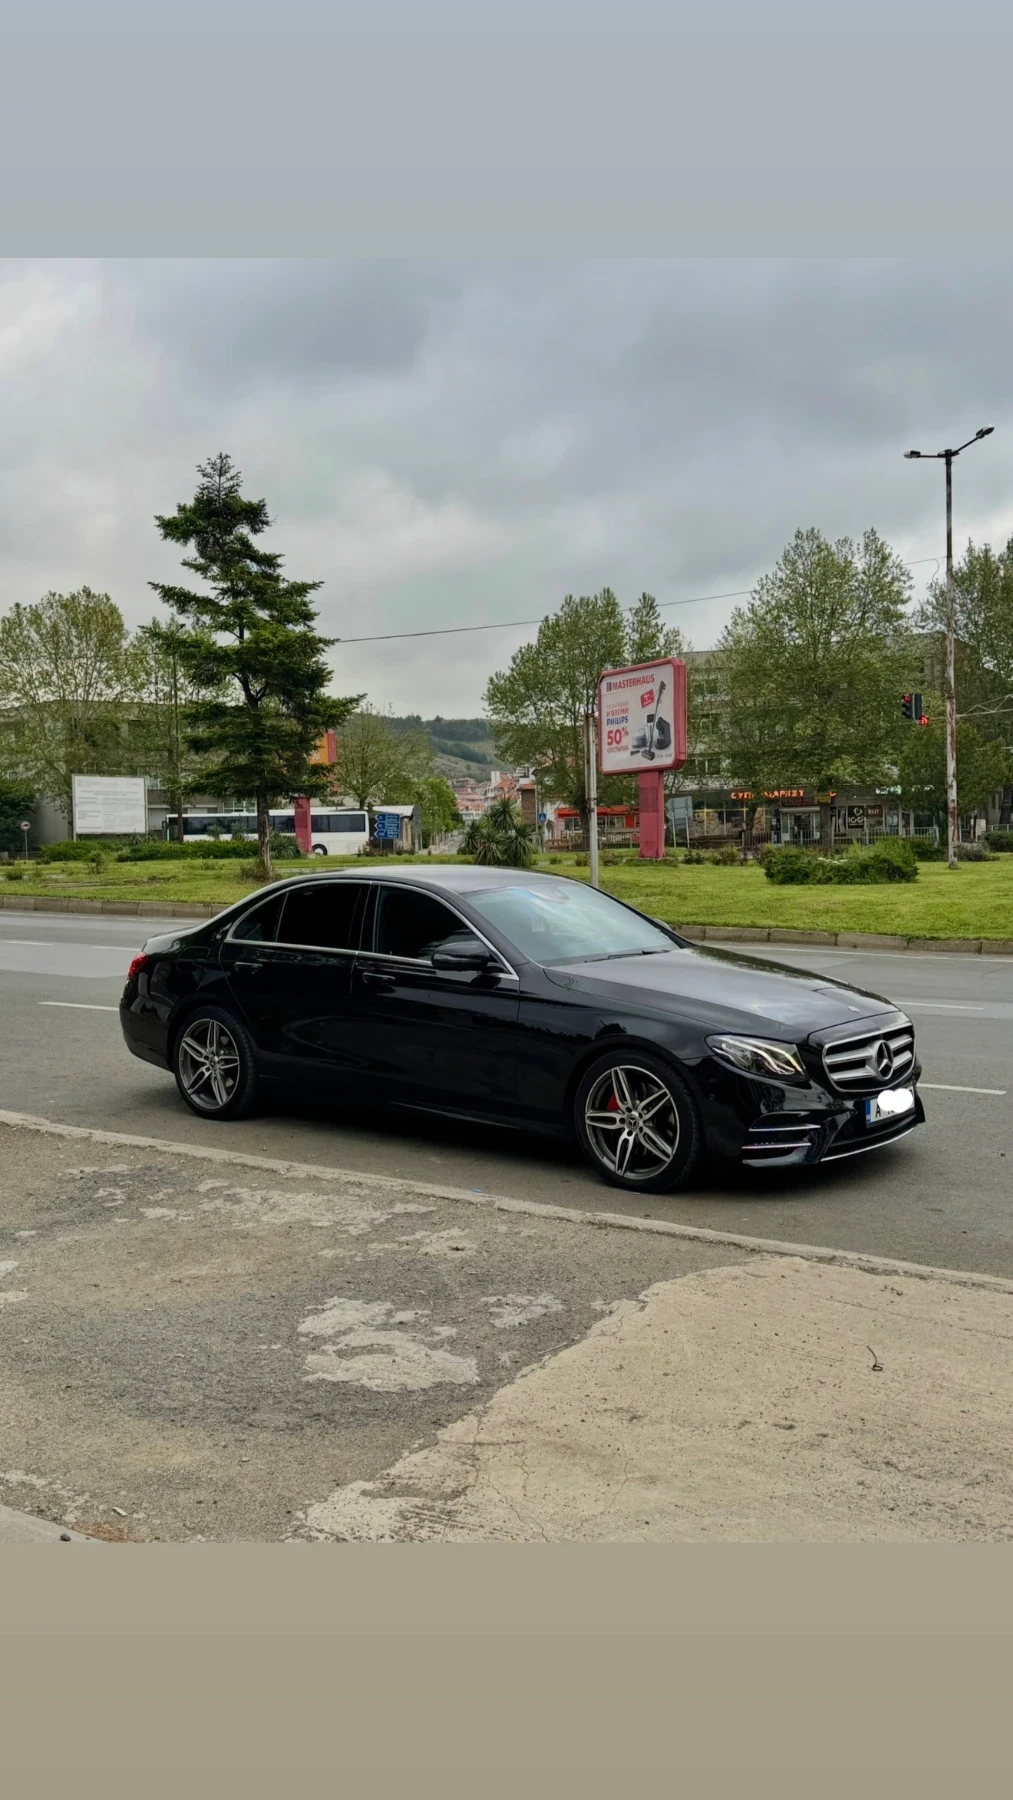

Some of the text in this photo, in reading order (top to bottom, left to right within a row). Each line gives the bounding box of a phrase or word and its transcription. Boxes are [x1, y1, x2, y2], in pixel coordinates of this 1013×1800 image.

[612, 674, 655, 690] MASTERHAUS
[611, 707, 629, 717] ВЗЕМИ
[606, 716, 629, 726] PHILIPS
[607, 727, 629, 746] 50%
[730, 789, 805, 800] СУПМАРКЕТ
